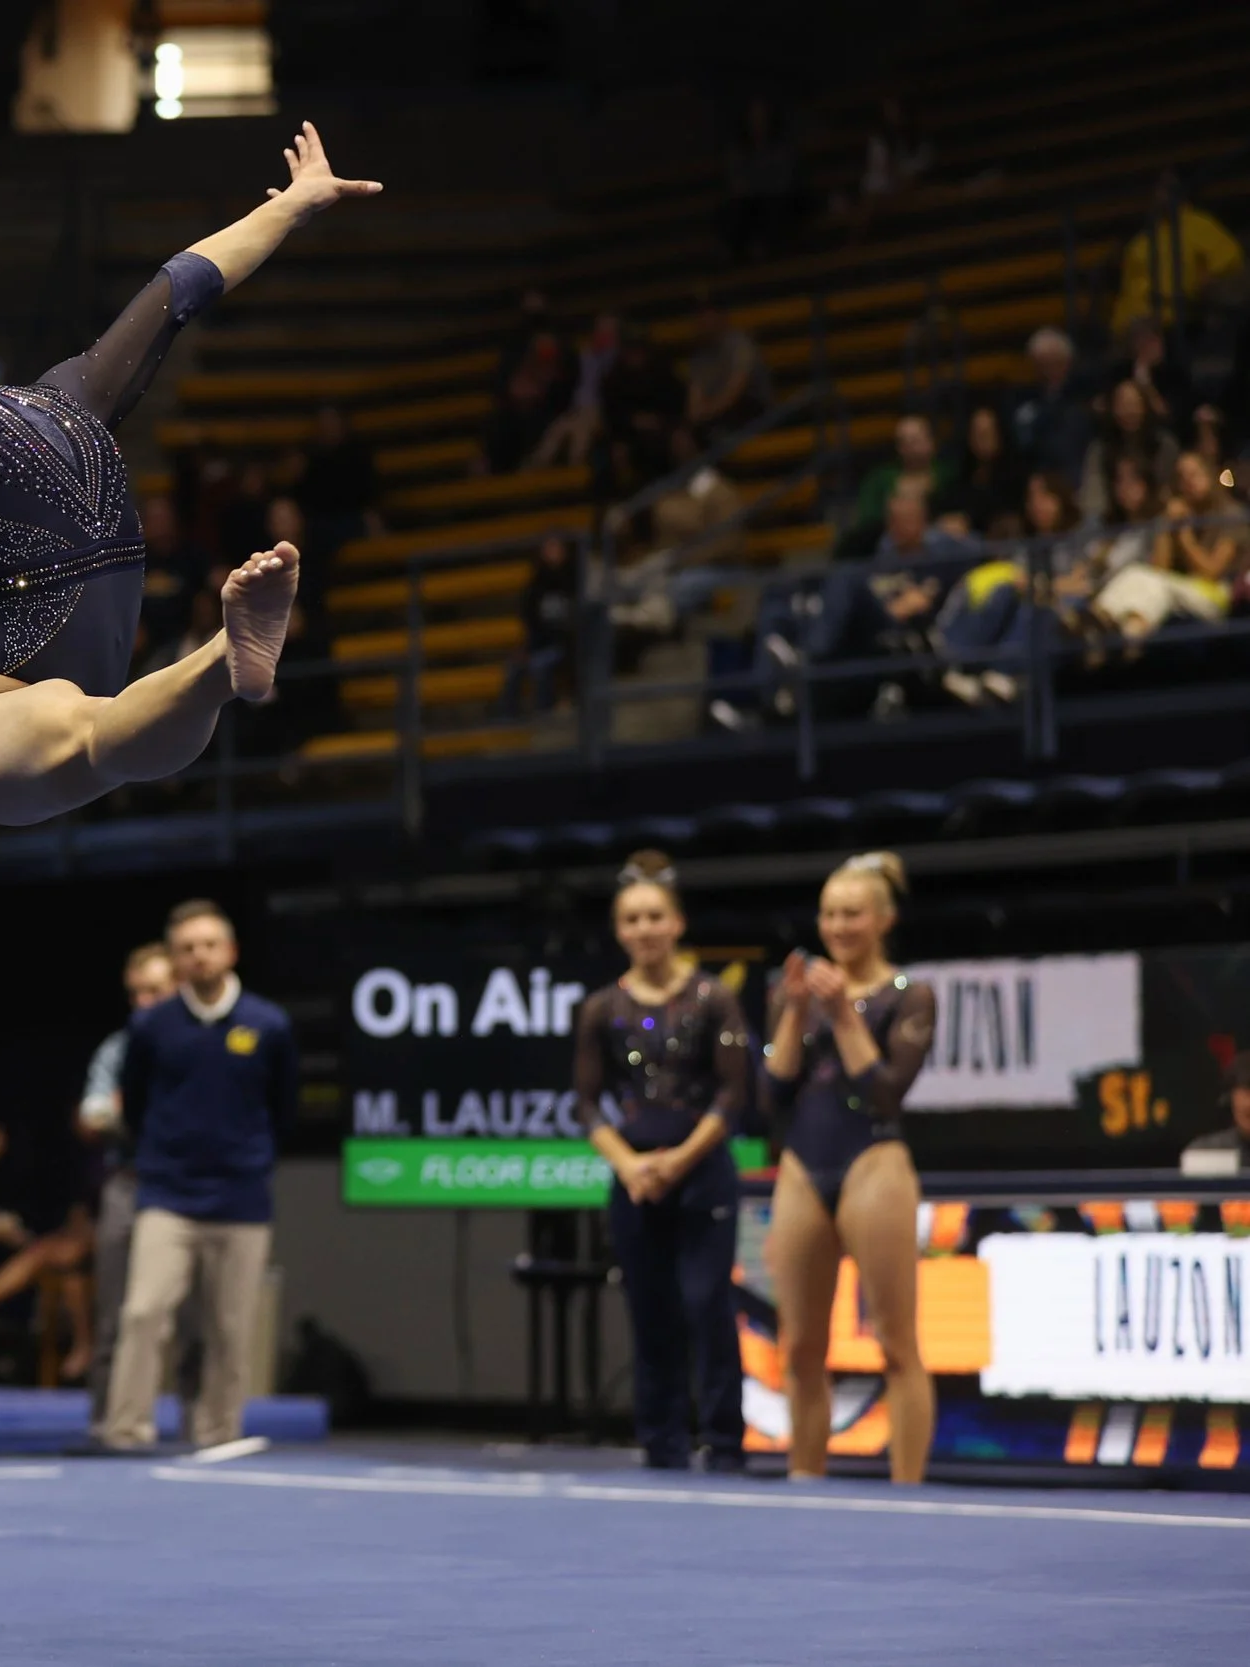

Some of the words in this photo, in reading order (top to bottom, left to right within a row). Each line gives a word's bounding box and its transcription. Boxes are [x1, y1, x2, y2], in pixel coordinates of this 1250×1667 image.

[351, 966, 458, 1037] On
[471, 966, 583, 1037] Air
[352, 1088, 411, 1136] M.
[421, 1154, 528, 1189] FLOOR
[1094, 1254, 1243, 1361] LAUZON
